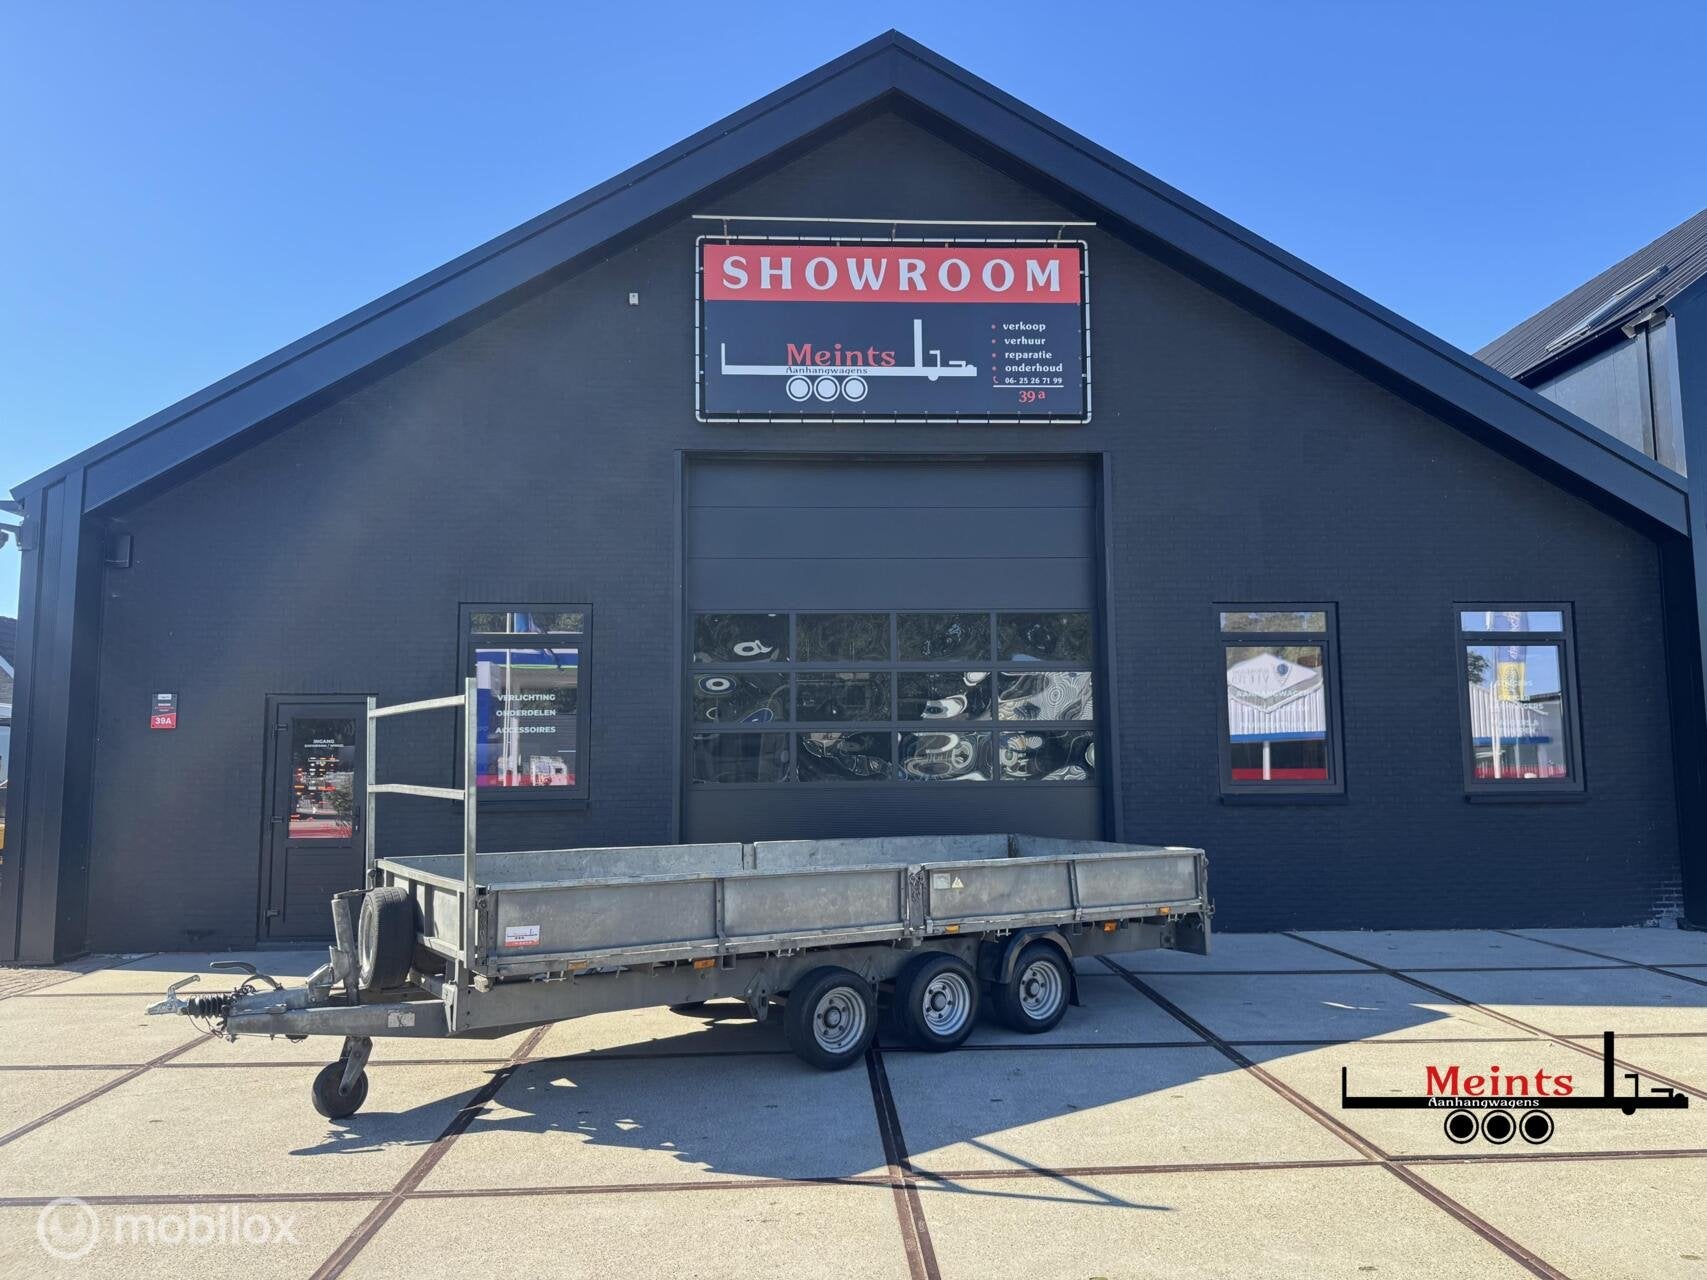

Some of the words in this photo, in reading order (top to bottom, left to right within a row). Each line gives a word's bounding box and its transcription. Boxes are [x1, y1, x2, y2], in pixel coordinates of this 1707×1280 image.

[722, 255, 1061, 292] SHOWROOM
[1003, 321, 1046, 332] verkoop
[1004, 335, 1046, 345] verhuur
[786, 343, 896, 367] Meints
[1005, 350, 1053, 361] reparatie
[785, 366, 868, 375] Aanhangwagens
[1005, 362, 1063, 372] onderhoud
[497, 694, 556, 702] VERLICHTING
[496, 709, 556, 717] ONDERDELEN
[495, 726, 556, 734] ACCESSOIRES
